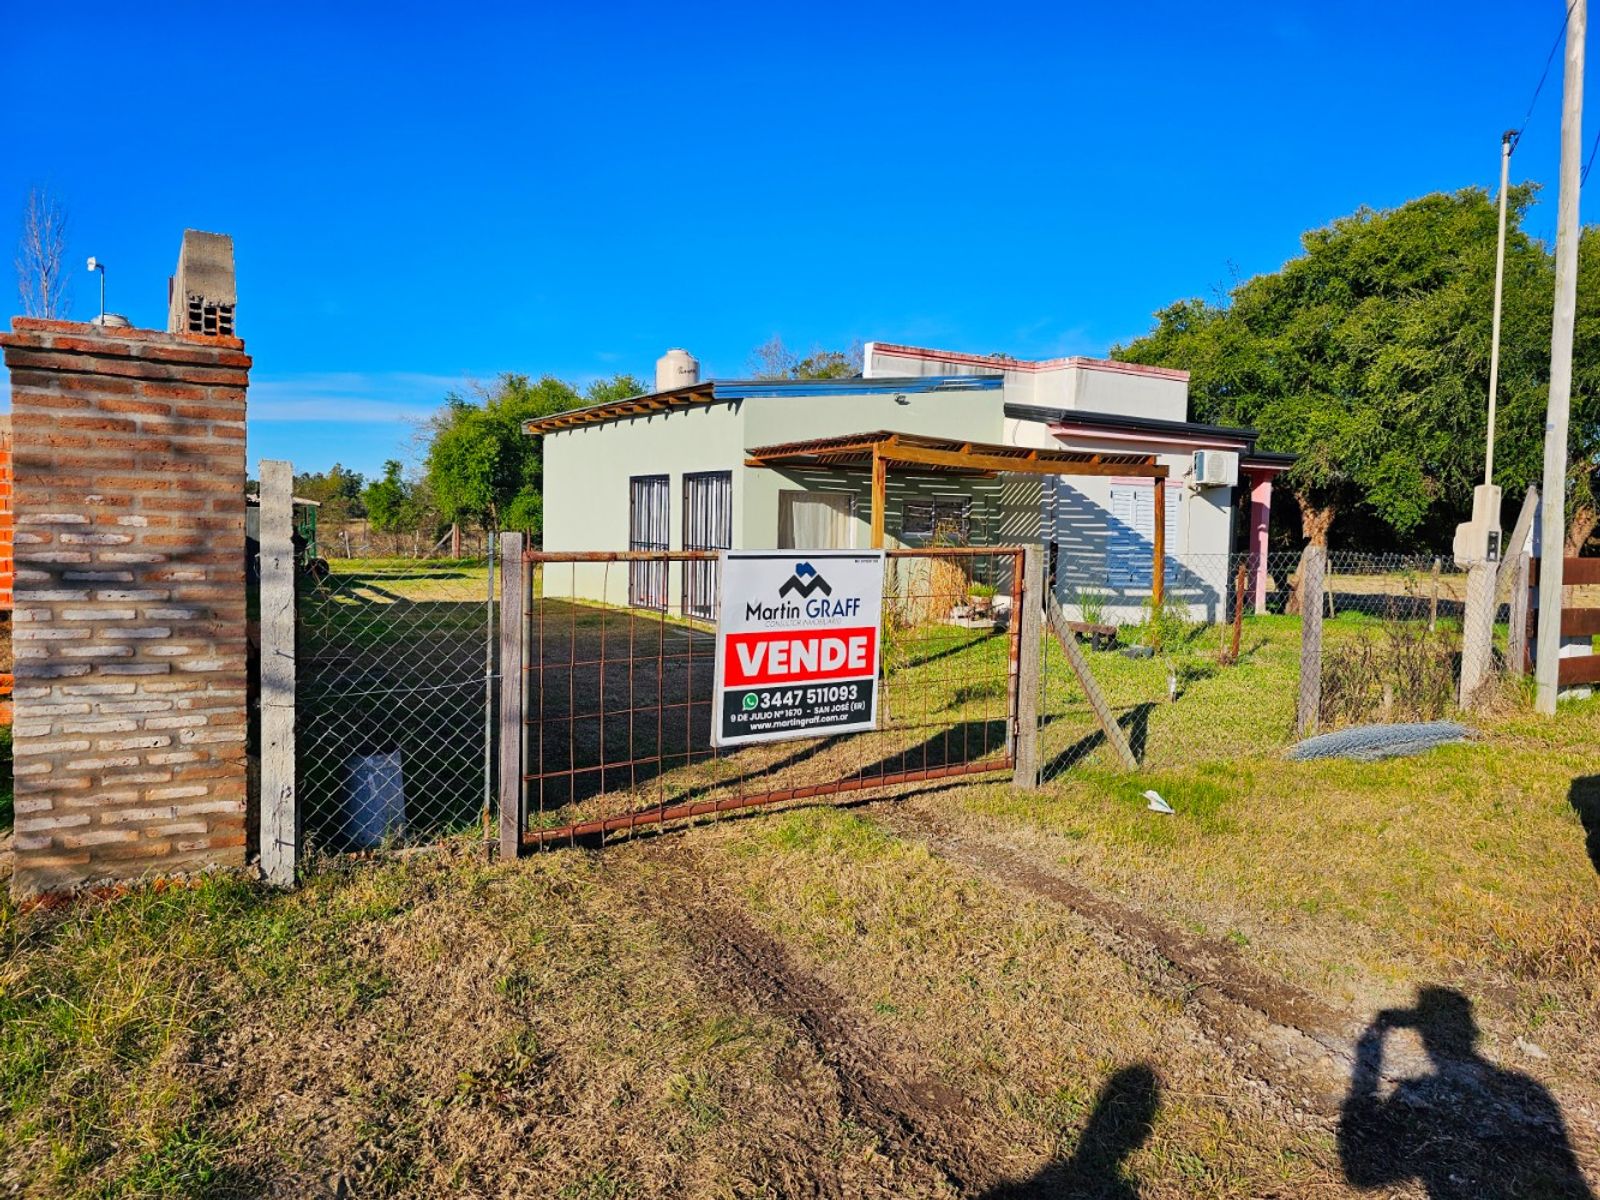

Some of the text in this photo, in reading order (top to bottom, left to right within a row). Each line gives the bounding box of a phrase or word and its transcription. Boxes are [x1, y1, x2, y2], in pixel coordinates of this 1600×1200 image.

[746, 597, 861, 621] Martin GRAFF
[735, 635, 868, 677] VENDE
[760, 685, 858, 709] 3447 511093
[730, 714, 736, 723] 9
[737, 713, 748, 722] DE
[749, 711, 772, 721] JULIO
[785, 708, 802, 717] 1670
[814, 706, 830, 714] SAN
[831, 702, 849, 713] JOSÉ
[850, 700, 866, 712] (ER)
[750, 713, 848, 730] www.martingraff.com.ar
